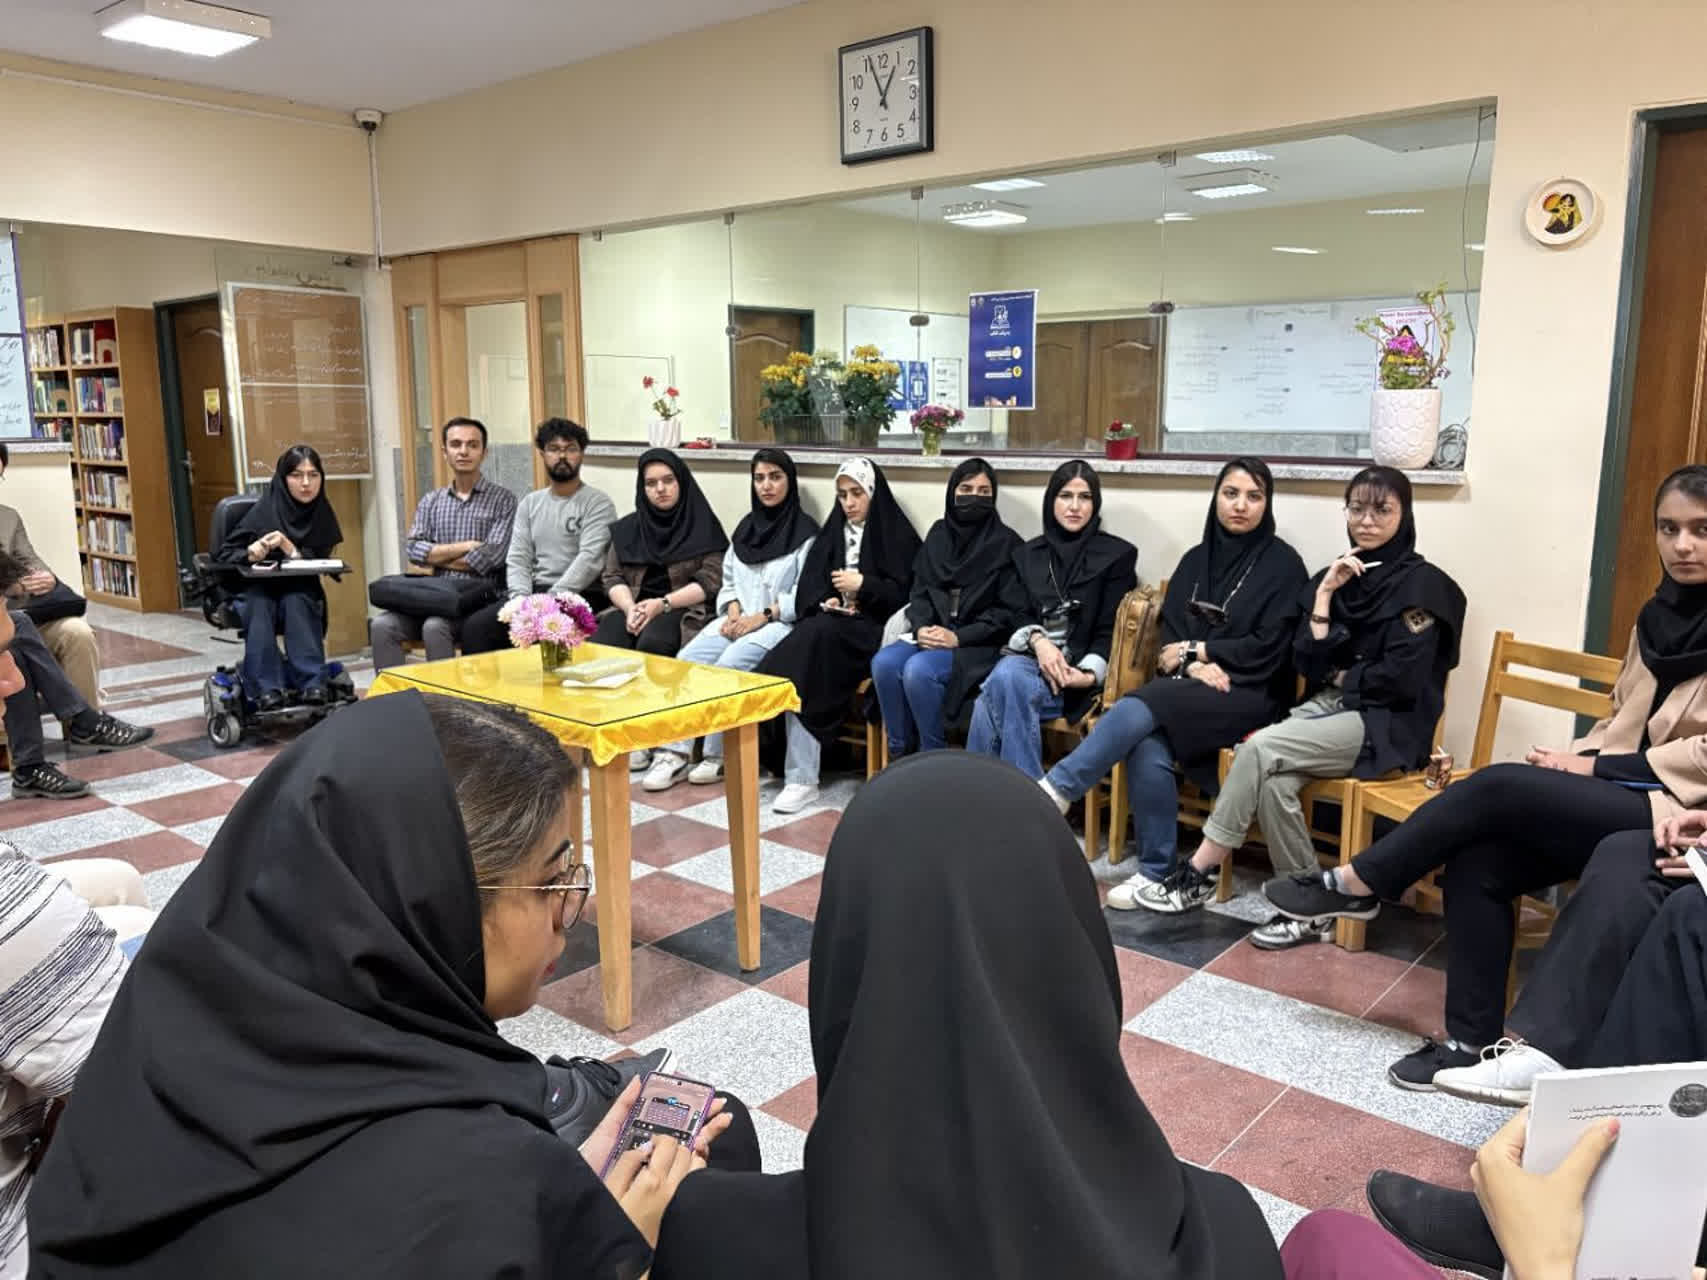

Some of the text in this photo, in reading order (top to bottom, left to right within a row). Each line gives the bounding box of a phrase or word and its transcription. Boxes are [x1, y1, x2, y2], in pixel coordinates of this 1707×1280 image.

[878, 53, 888, 68] 12
[908, 59, 916, 74] 2
[852, 75, 863, 90] 10
[909, 84, 917, 100] 3
[852, 97, 859, 111] 9
[908, 108, 916, 122] 4
[853, 120, 860, 134] 8
[881, 128, 888, 141] 6
[896, 123, 905, 138] 5
[866, 129, 873, 144] 7
